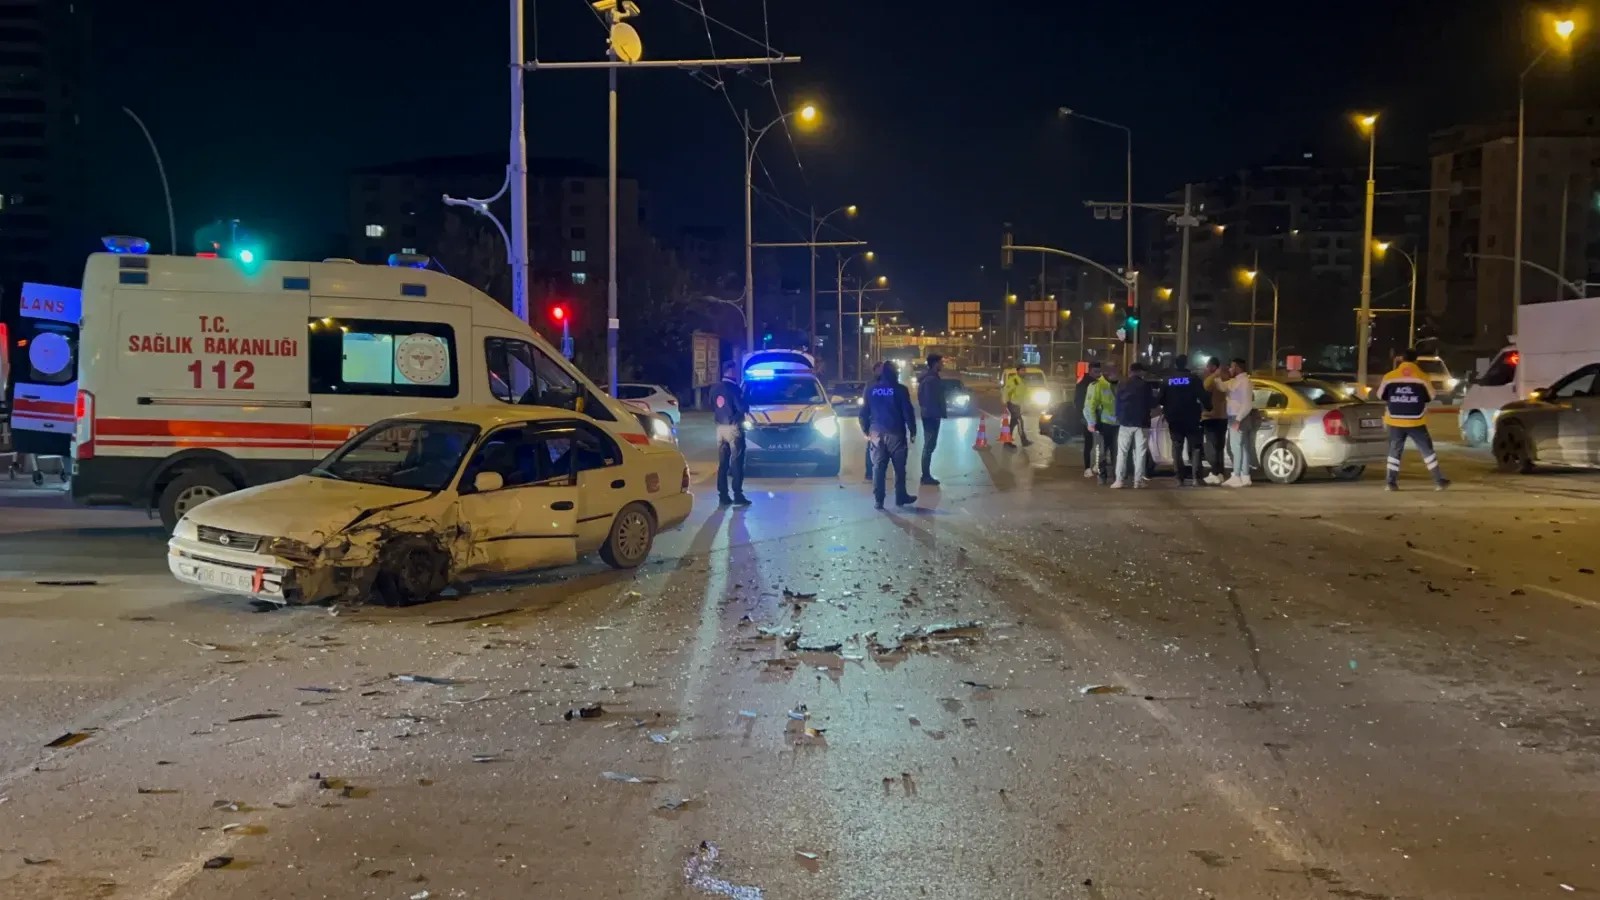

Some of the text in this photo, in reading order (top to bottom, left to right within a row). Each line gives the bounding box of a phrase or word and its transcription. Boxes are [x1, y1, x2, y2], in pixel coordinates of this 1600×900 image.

[20, 296, 65, 313] LANS
[199, 315, 230, 333] T.C.
[128, 332, 298, 357] SAĞLIK BAKANLIĞI
[187, 359, 255, 390] 112
